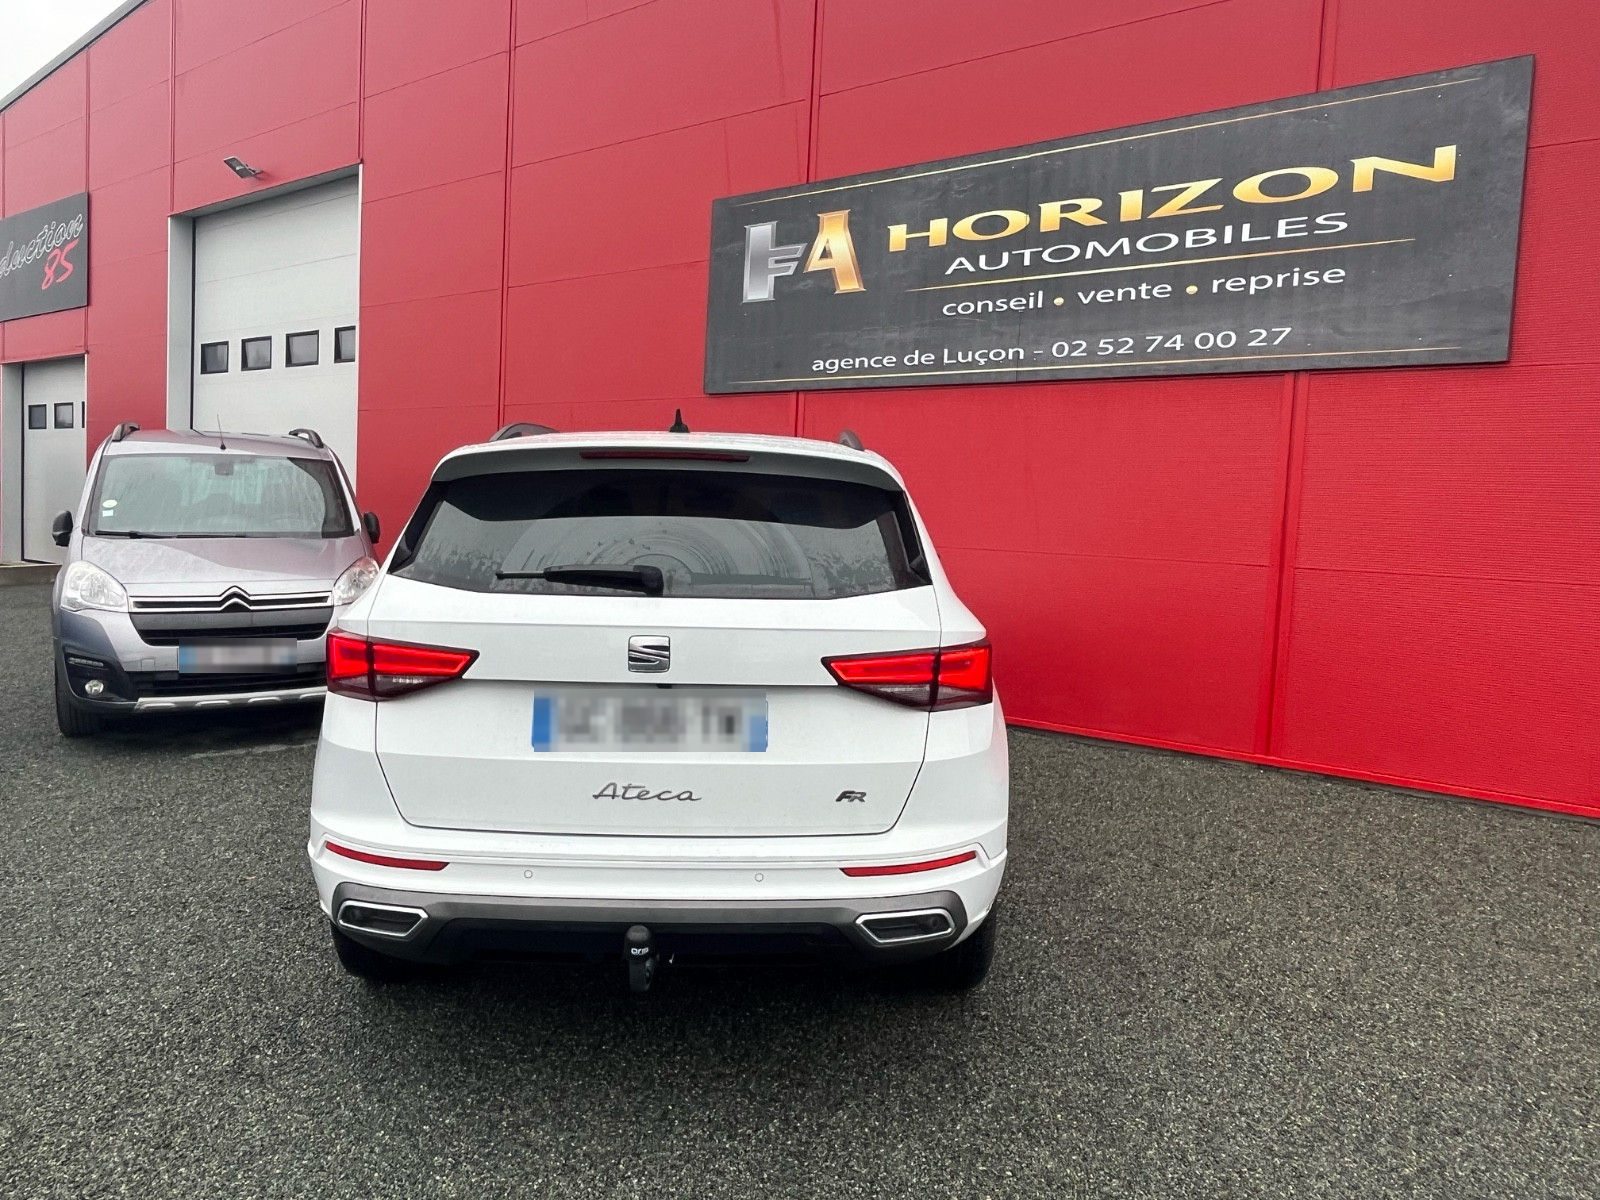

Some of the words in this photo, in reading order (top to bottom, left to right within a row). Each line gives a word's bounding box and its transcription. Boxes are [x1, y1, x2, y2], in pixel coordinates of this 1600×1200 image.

[887, 144, 1458, 253] HORIZON
[41, 239, 79, 290] 85
[944, 211, 1349, 275] AUTOMOBILES
[942, 290, 1044, 316] conseil
[1077, 282, 1173, 305] vente
[1211, 266, 1347, 295] reprise
[811, 356, 897, 374] agence
[903, 349, 936, 366] de
[942, 346, 1025, 367] Luçon
[1051, 340, 1089, 358] 02
[1096, 337, 1134, 355] 52
[1145, 335, 1185, 353] 74
[1194, 331, 1237, 350] 00
[1247, 326, 1293, 347] 27
[592, 781, 702, 801] Ateca
[835, 790, 867, 803] FR
